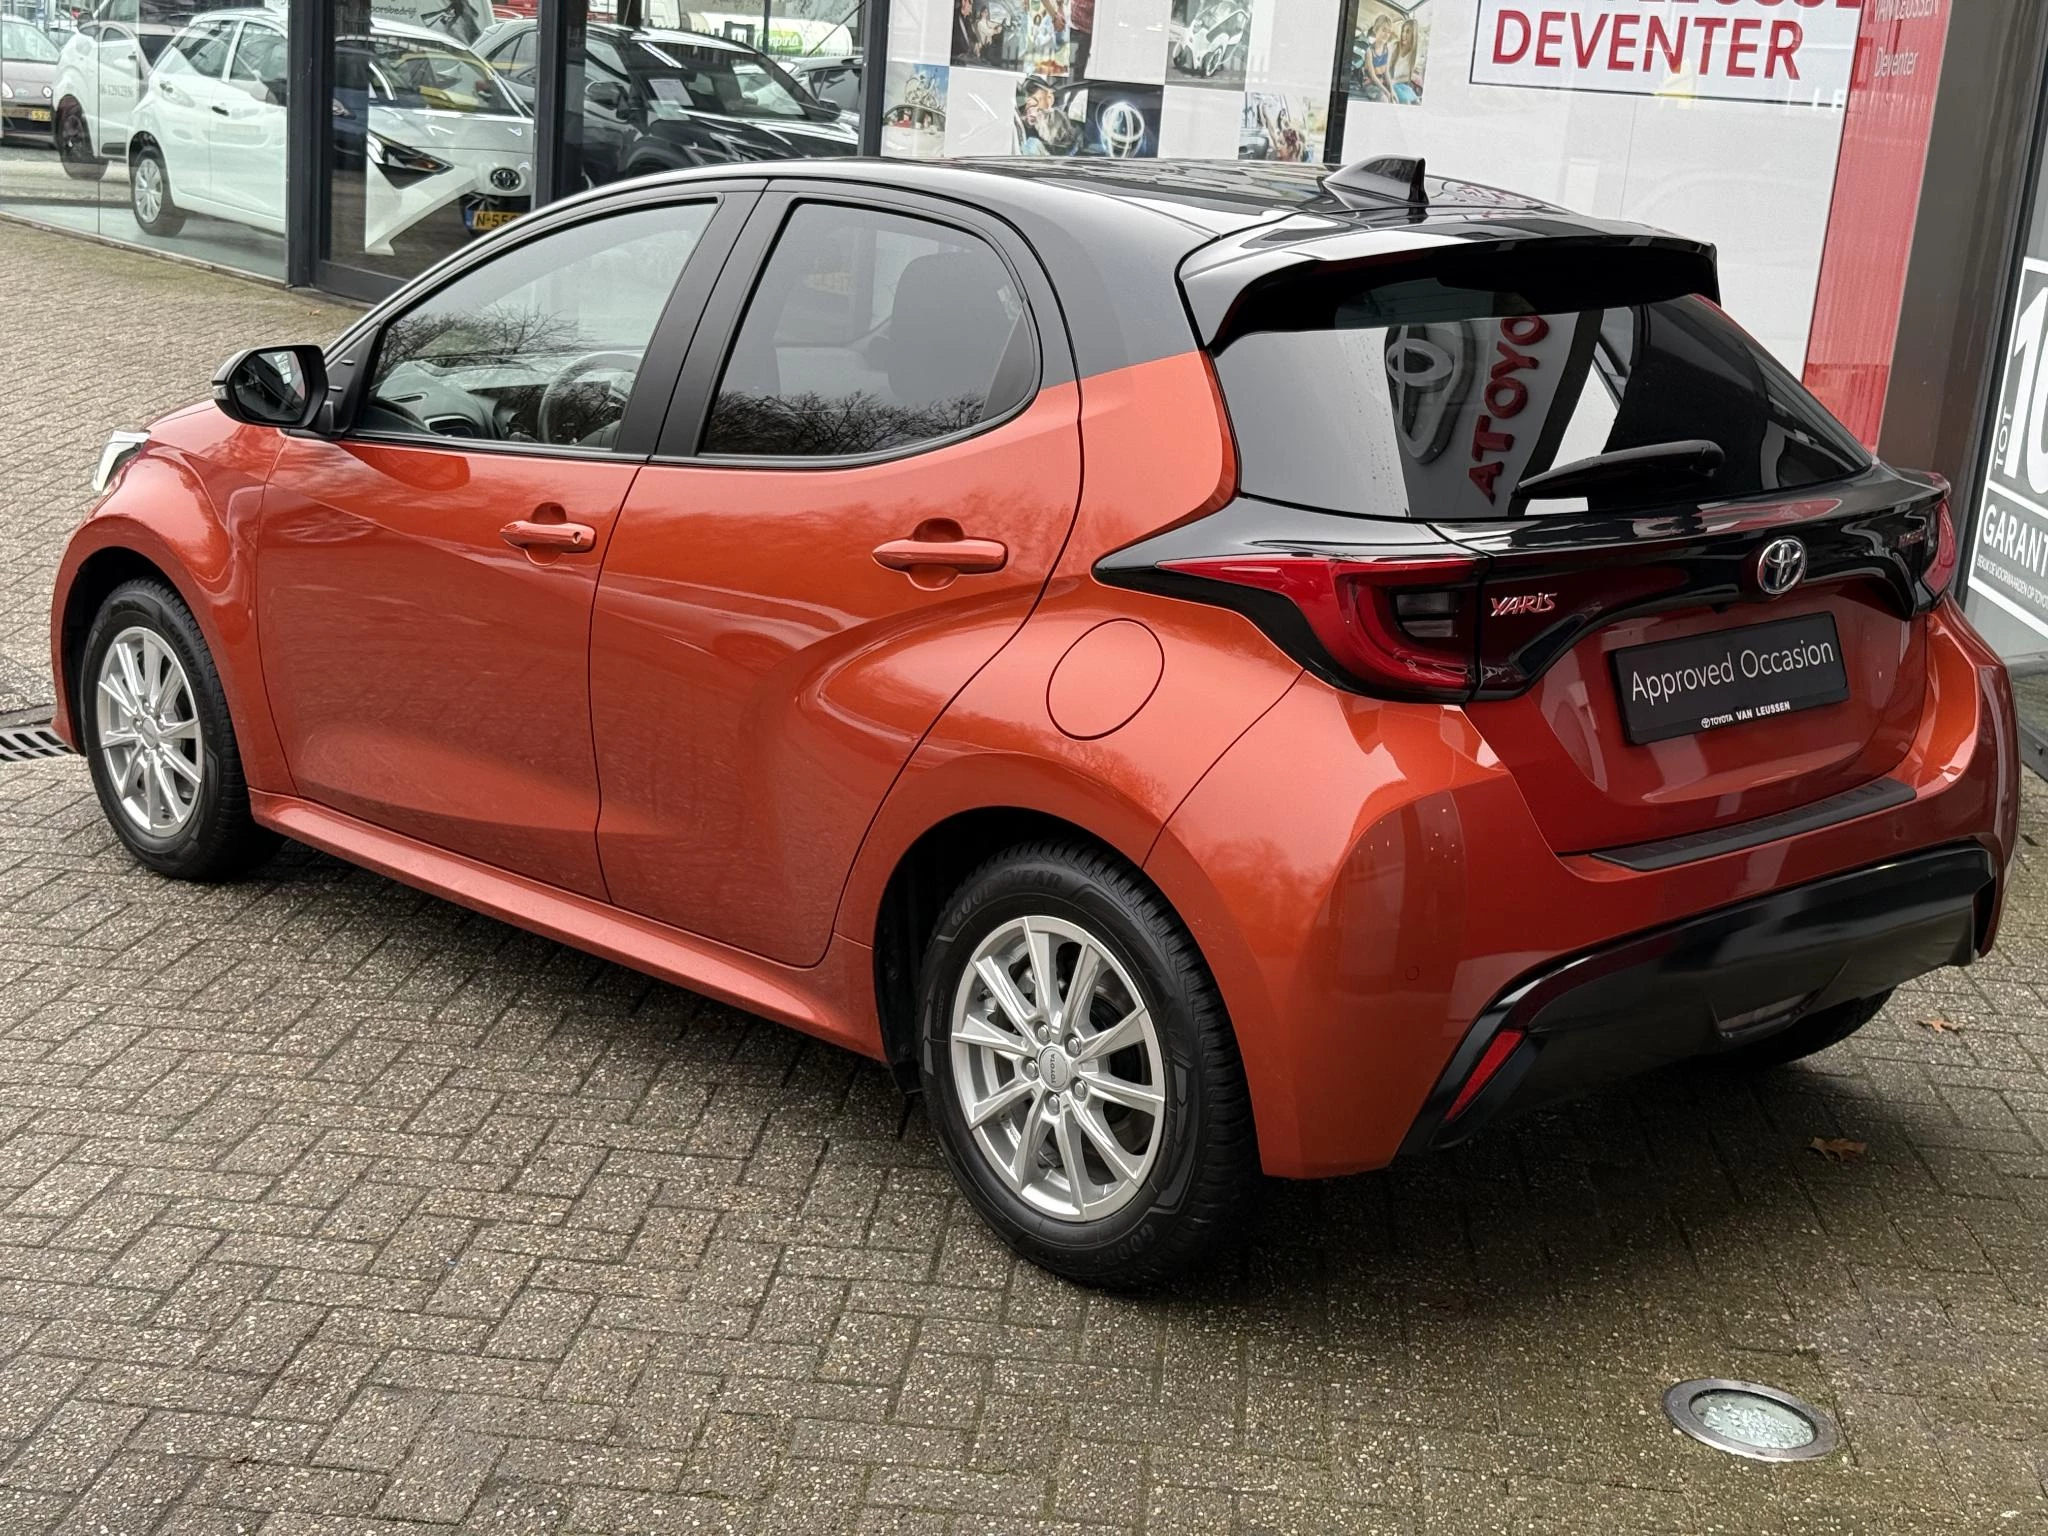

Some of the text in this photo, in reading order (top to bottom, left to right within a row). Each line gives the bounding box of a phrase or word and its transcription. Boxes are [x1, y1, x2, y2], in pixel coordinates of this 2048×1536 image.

[1492, 9, 1804, 81] DEVENTER
[1874, 46, 1919, 77] Deventer
[1994, 404, 2013, 471] TOT
[1491, 592, 1558, 617] YARIS
[1632, 640, 1834, 706] Approved Occasion
[1710, 701, 1791, 727] TOYOTA VAN LEUSSEN
